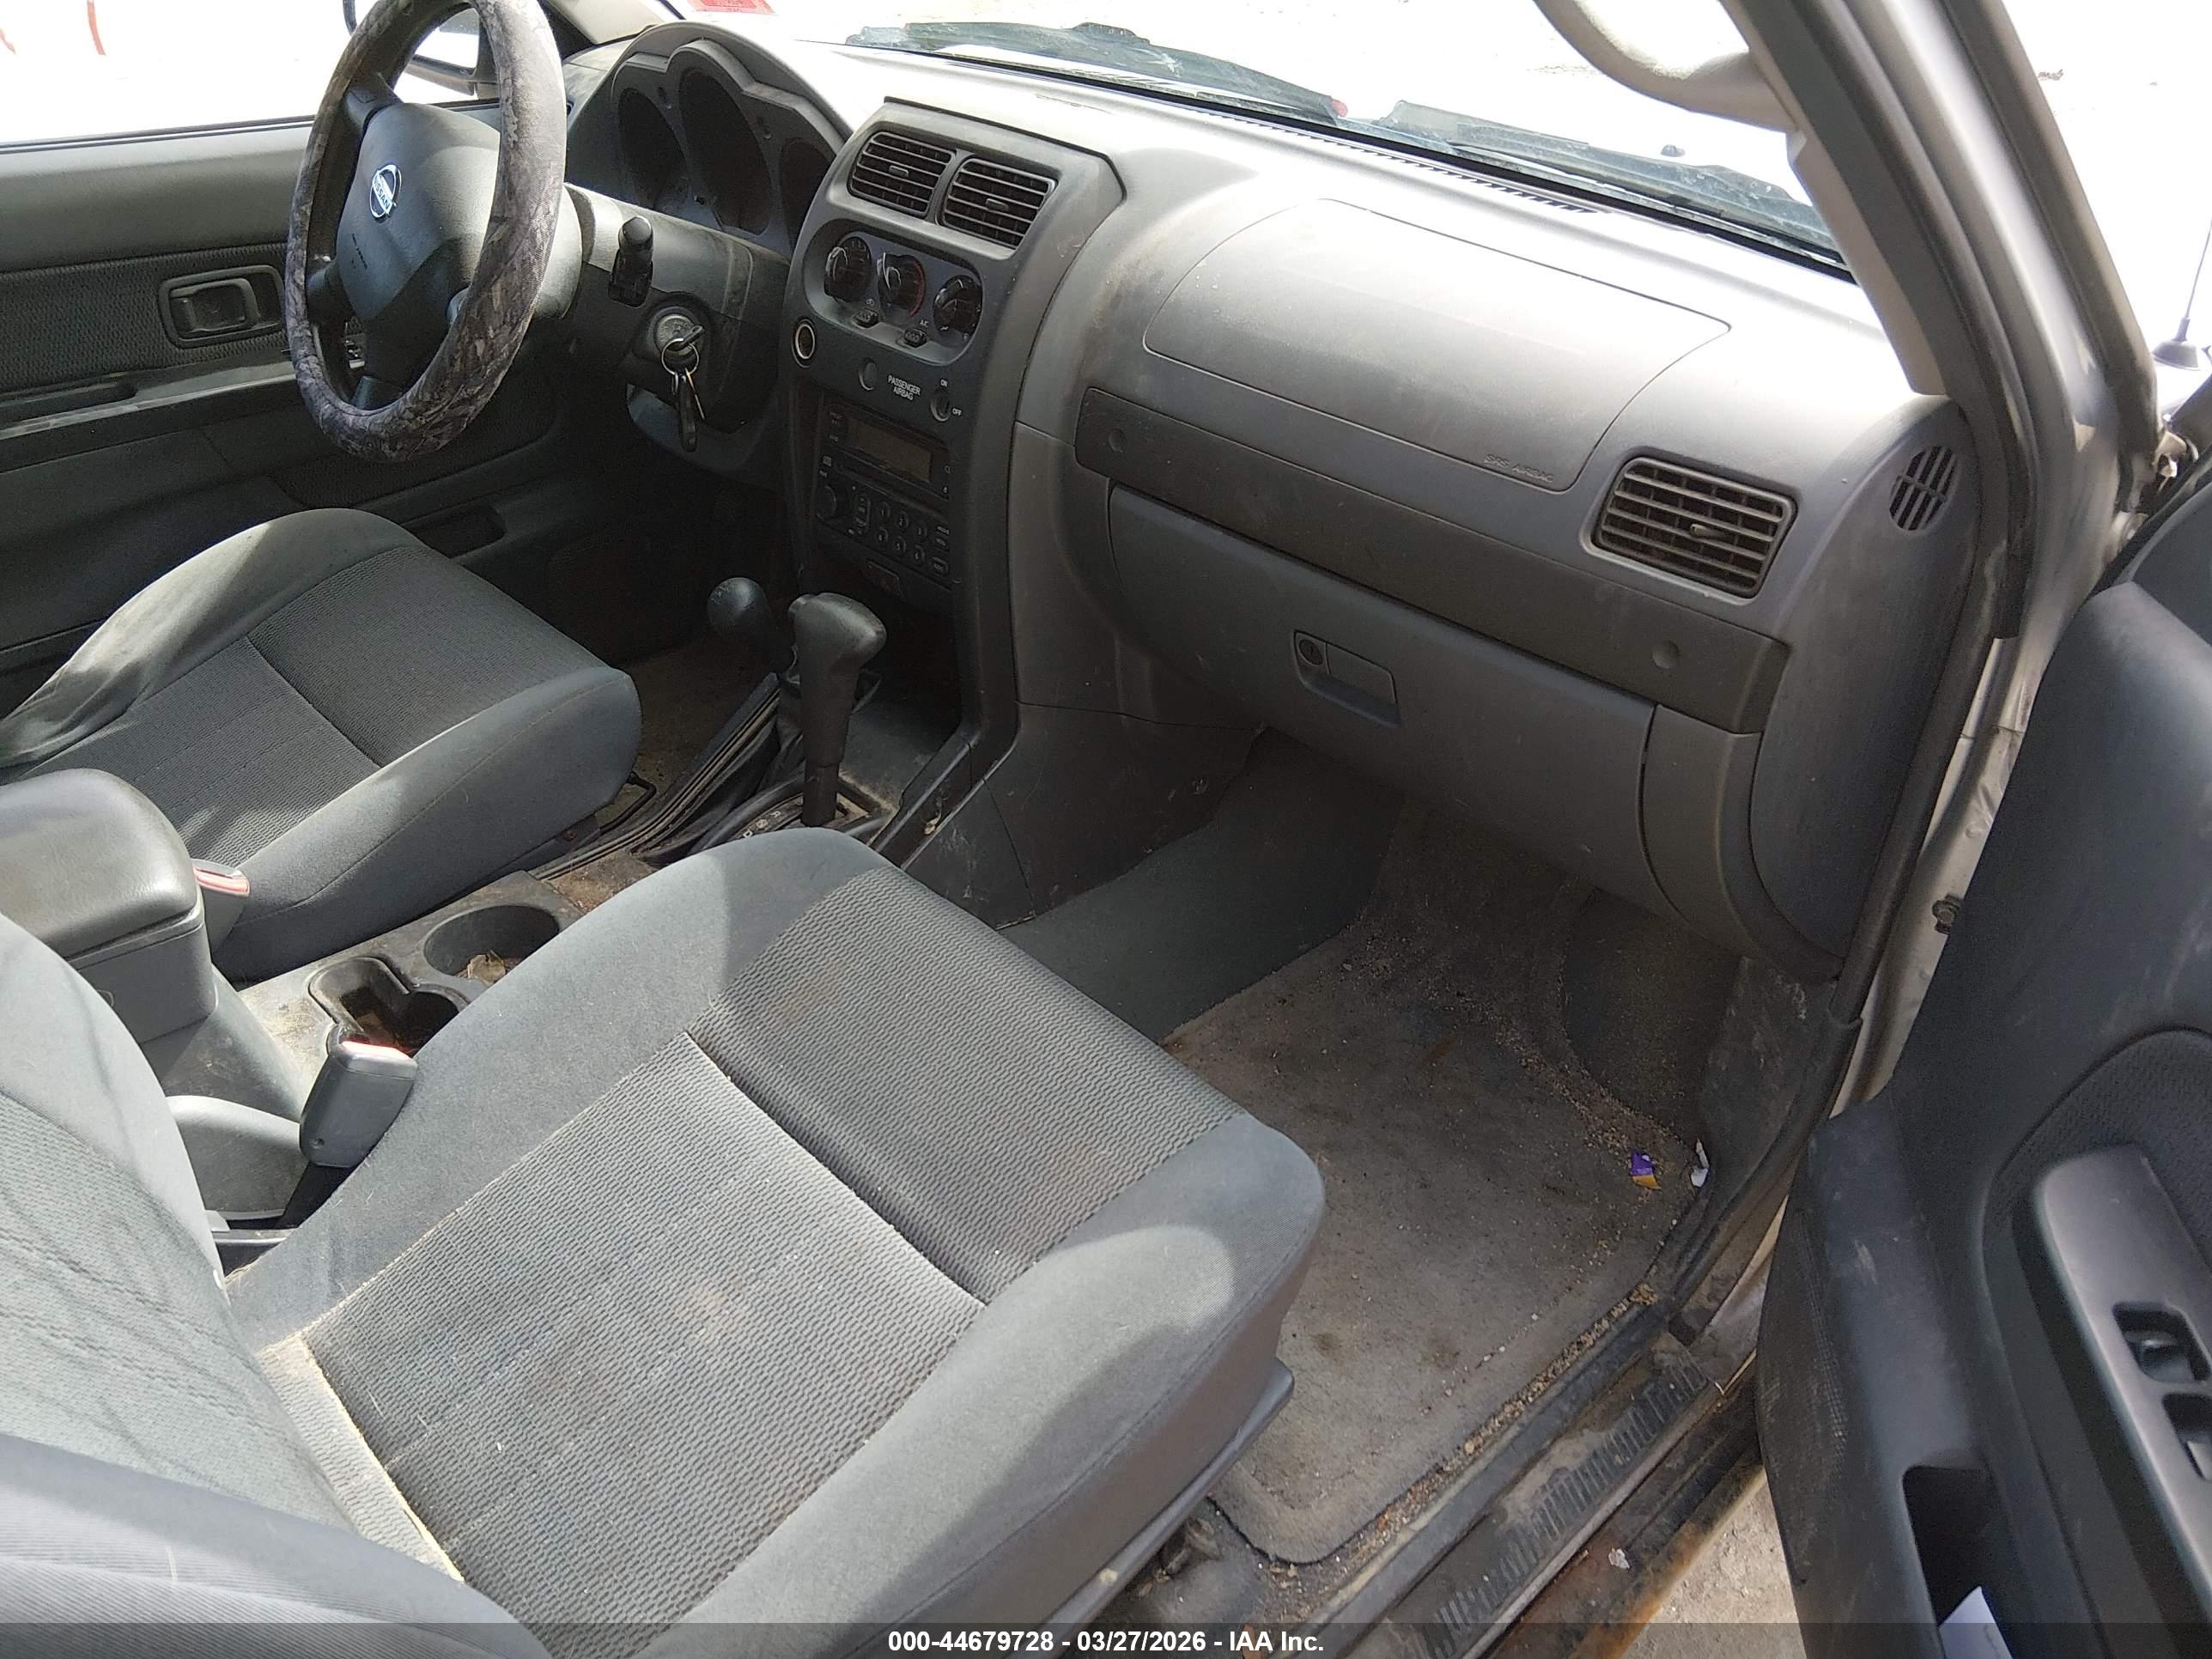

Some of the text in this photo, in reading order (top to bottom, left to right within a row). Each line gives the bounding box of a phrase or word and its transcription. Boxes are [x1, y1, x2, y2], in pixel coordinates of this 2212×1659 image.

[374, 175, 391, 209] NISSAN
[888, 374, 921, 396] PASSENGER
[893, 386, 914, 401] AIRBAG
